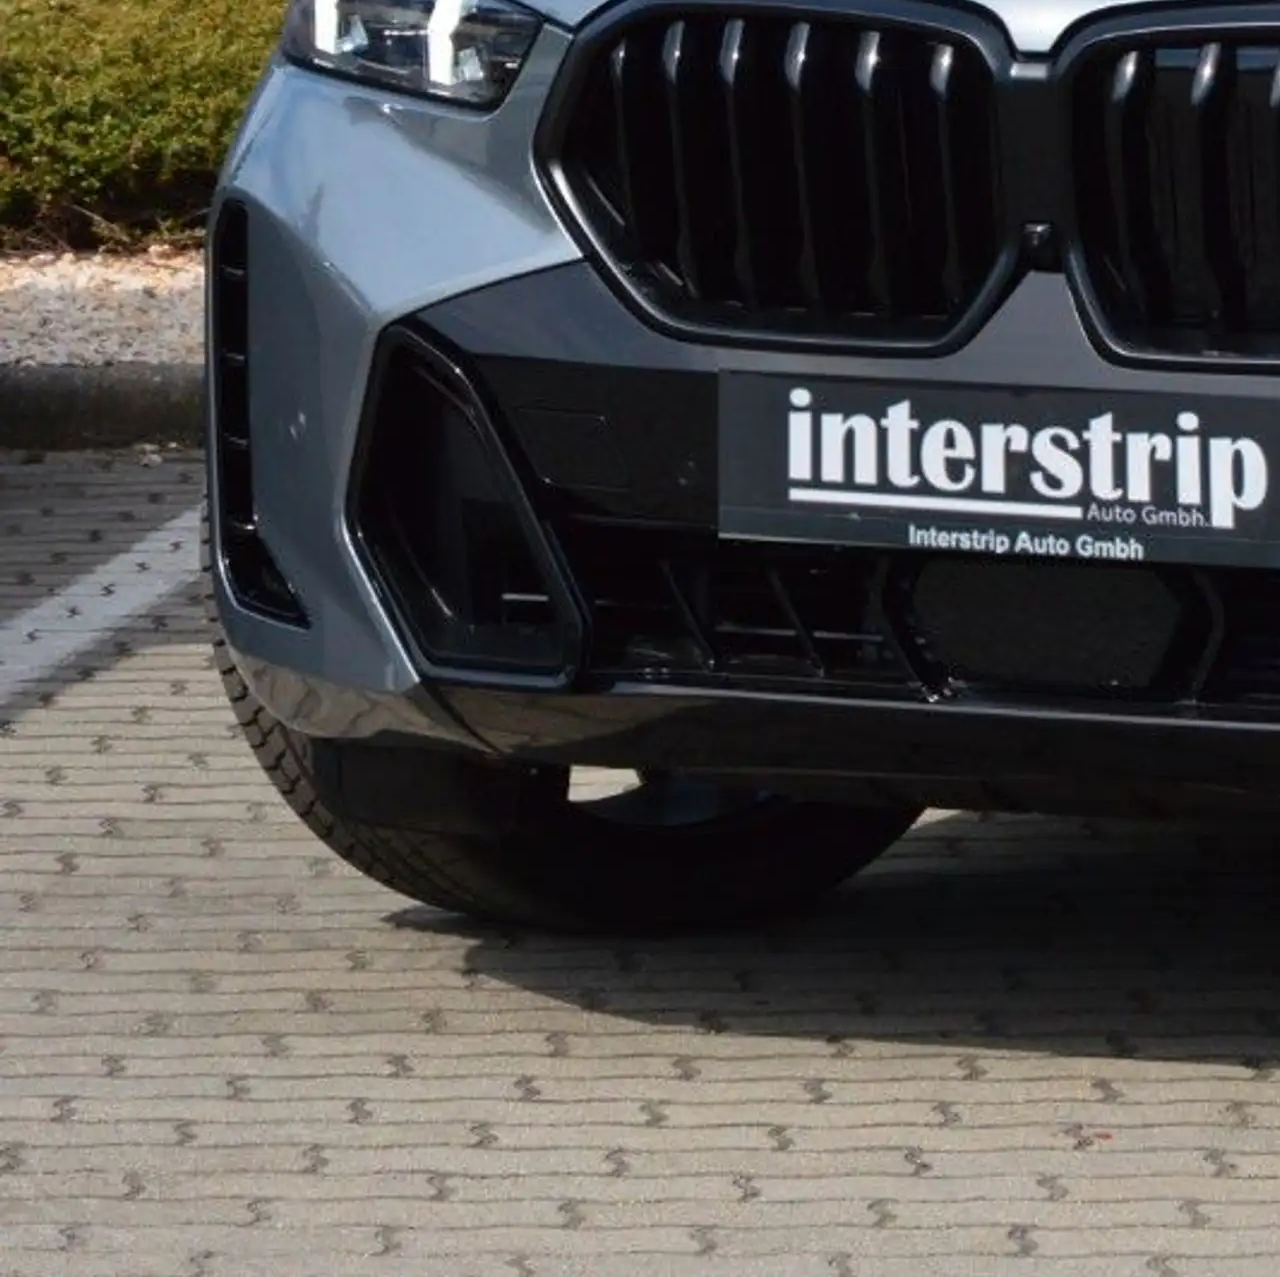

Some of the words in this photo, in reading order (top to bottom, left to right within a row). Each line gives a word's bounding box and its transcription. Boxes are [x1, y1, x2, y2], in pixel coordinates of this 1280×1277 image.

[788, 387, 1268, 528] interstrip
[1087, 502, 1137, 523] Auto
[908, 523, 1010, 554] Interstrip
[1014, 531, 1070, 556] Auto
[1075, 534, 1144, 560] Gmbh
